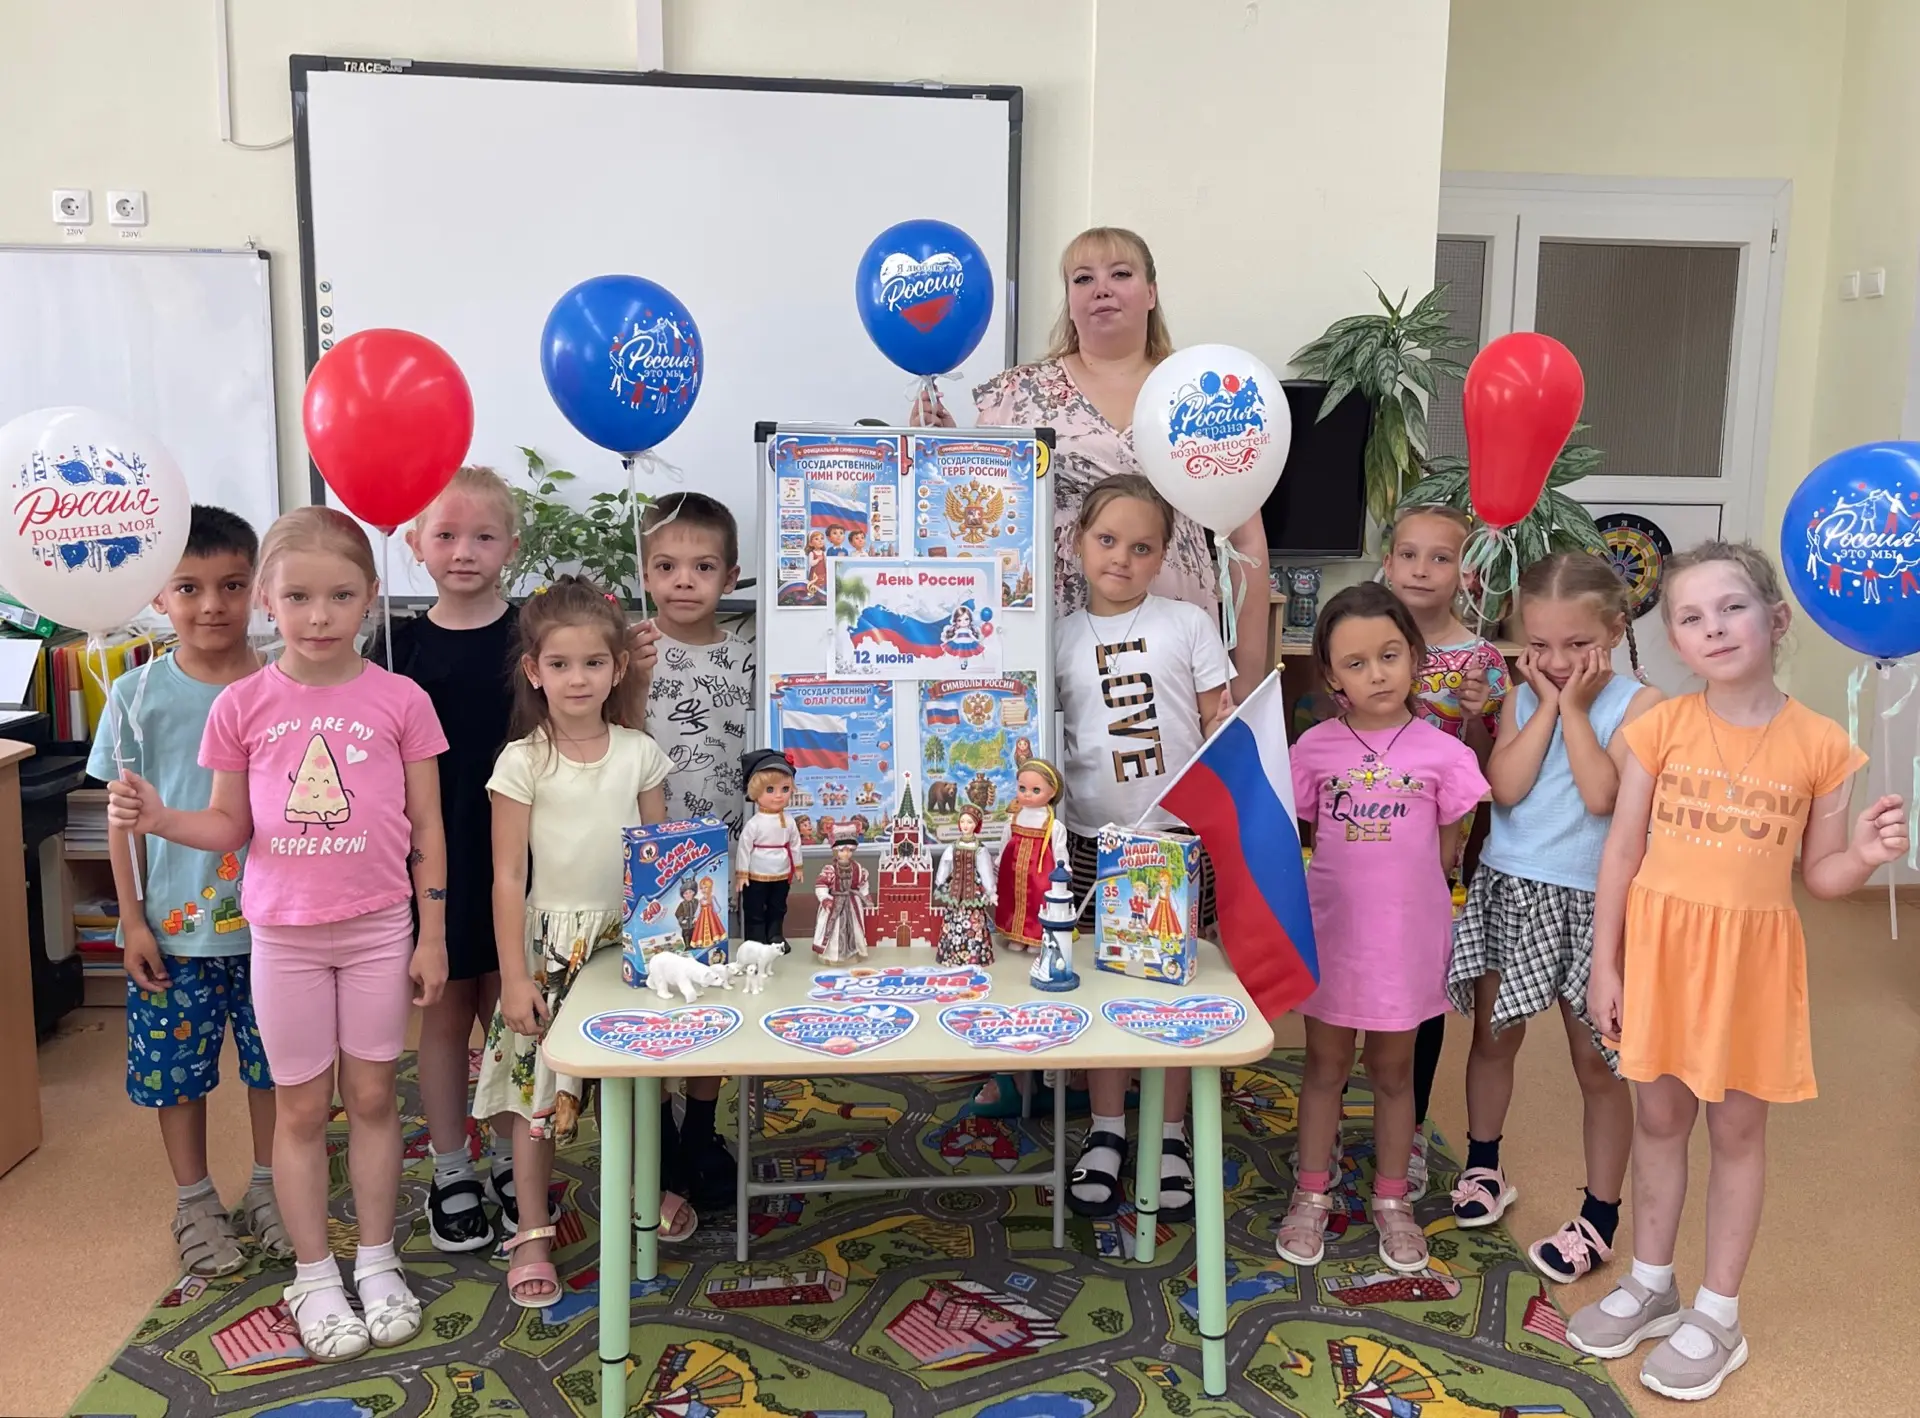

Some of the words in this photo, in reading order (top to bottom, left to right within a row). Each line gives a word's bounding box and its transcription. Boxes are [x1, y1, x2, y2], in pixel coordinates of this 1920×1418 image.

[880, 271, 964, 312] Россию
[1170, 391, 1255, 432] Россия
[1194, 422, 1244, 438] страна
[797, 460, 883, 470] ГОСУДАРСТВЕННЫЙ
[938, 456, 1012, 467] ГОСУДАРСТВЕННЫЙ
[805, 471, 833, 480] ГИМН
[836, 471, 875, 481] РОССИИ
[942, 467, 966, 476] ГЕРБ
[969, 467, 1008, 477] РОССИИ
[31, 523, 113, 545] родина
[119, 517, 156, 534] моя
[876, 572, 914, 586] День
[918, 572, 975, 586] России
[853, 651, 871, 664] 12
[876, 653, 914, 664] июня
[797, 686, 872, 696] ГОСУДАРСТВЕННЫЙ
[941, 680, 982, 692] СИМВОЛЫ
[984, 679, 1015, 690] РОССИИ
[803, 696, 828, 705] ФЛАГ
[831, 696, 867, 704] РОССИИ
[1095, 637, 1166, 783] LOVE
[266, 718, 301, 743] YOU
[310, 716, 346, 731] ARE
[348, 721, 374, 741] MY
[1332, 790, 1410, 830] Queen
[1345, 821, 1392, 842] BEE
[655, 838, 697, 871] НАША
[1124, 842, 1159, 856] НАША
[655, 843, 711, 888] РОДИНА
[1118, 854, 1167, 869] РОДИНА
[1103, 885, 1119, 898] 35
[801, 1015, 866, 1023] СИЛА
[981, 1017, 1053, 1028] НАШЕ
[616, 1022, 705, 1033] СЕМЬЯ
[967, 1023, 1079, 1037] БУДУЩЕЕ
[627, 1037, 694, 1049] ДОМ
